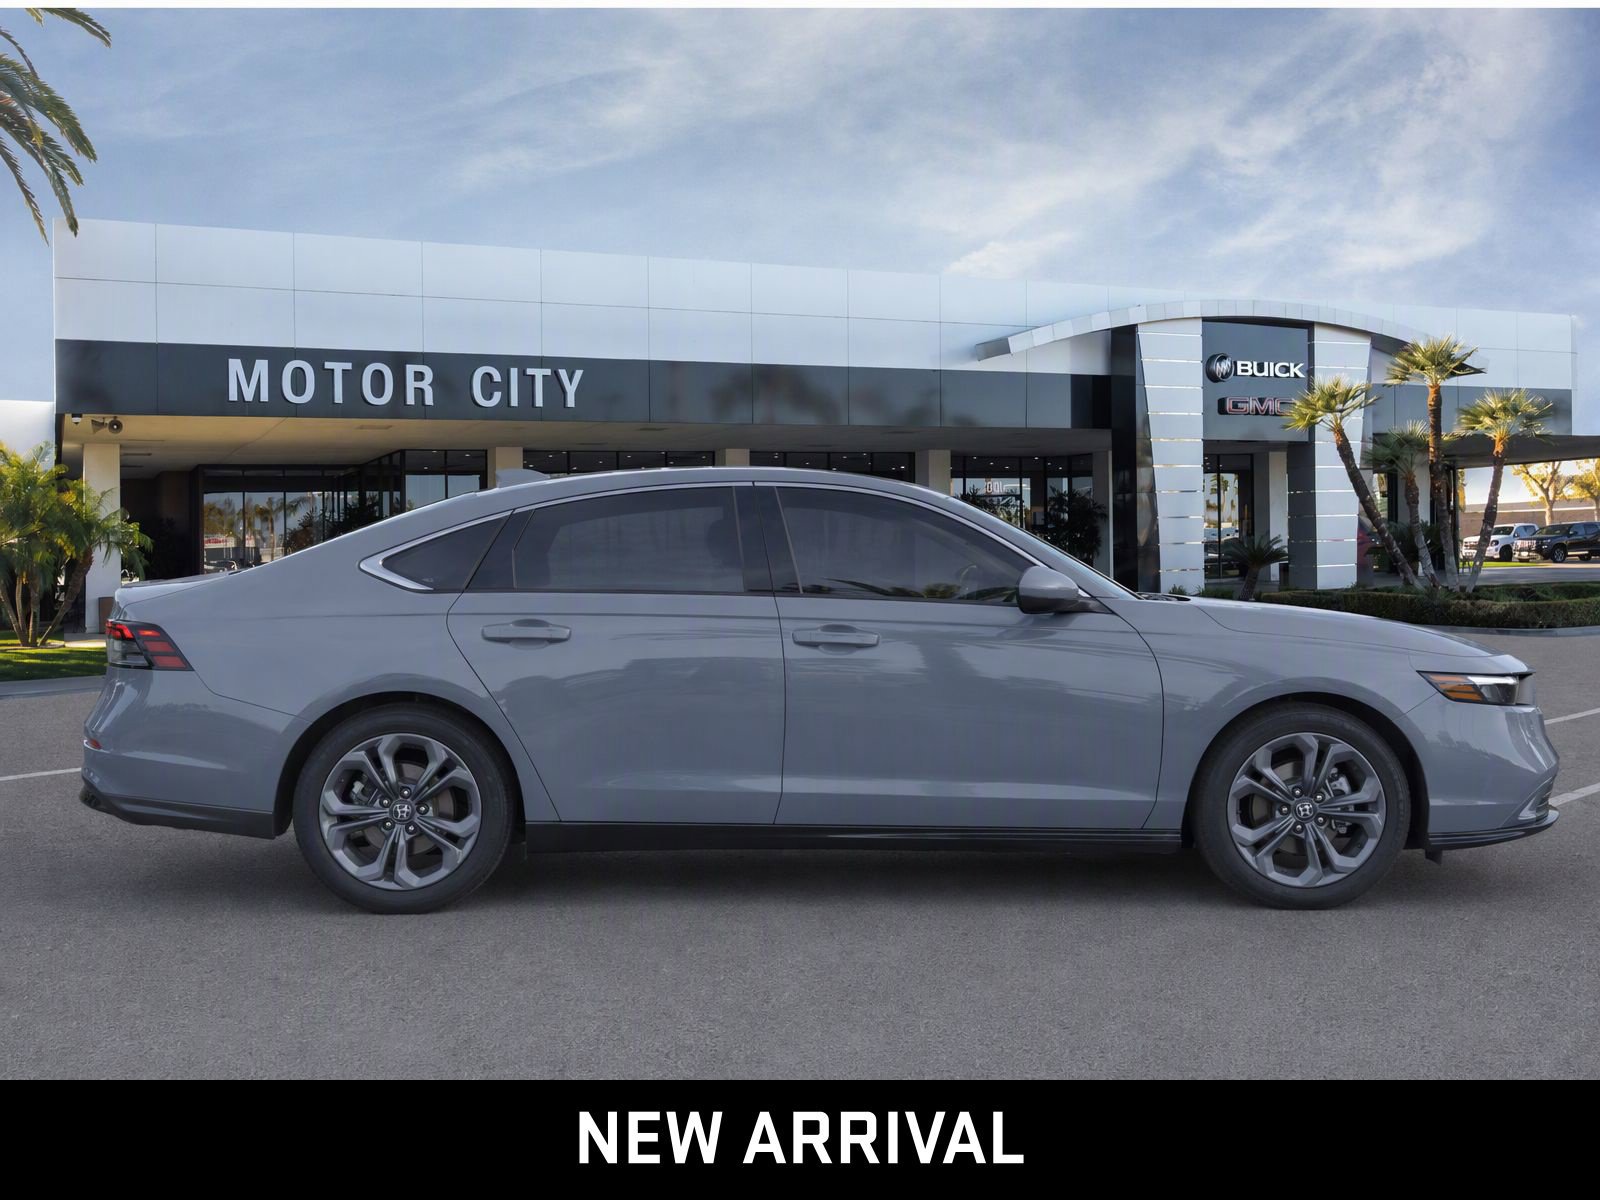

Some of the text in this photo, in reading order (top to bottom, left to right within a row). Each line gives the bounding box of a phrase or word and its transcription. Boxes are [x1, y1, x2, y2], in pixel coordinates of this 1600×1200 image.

[1236, 360, 1306, 378] BUICK
[227, 358, 584, 408] MOTOR CITY
[1226, 396, 1296, 416] GMC
